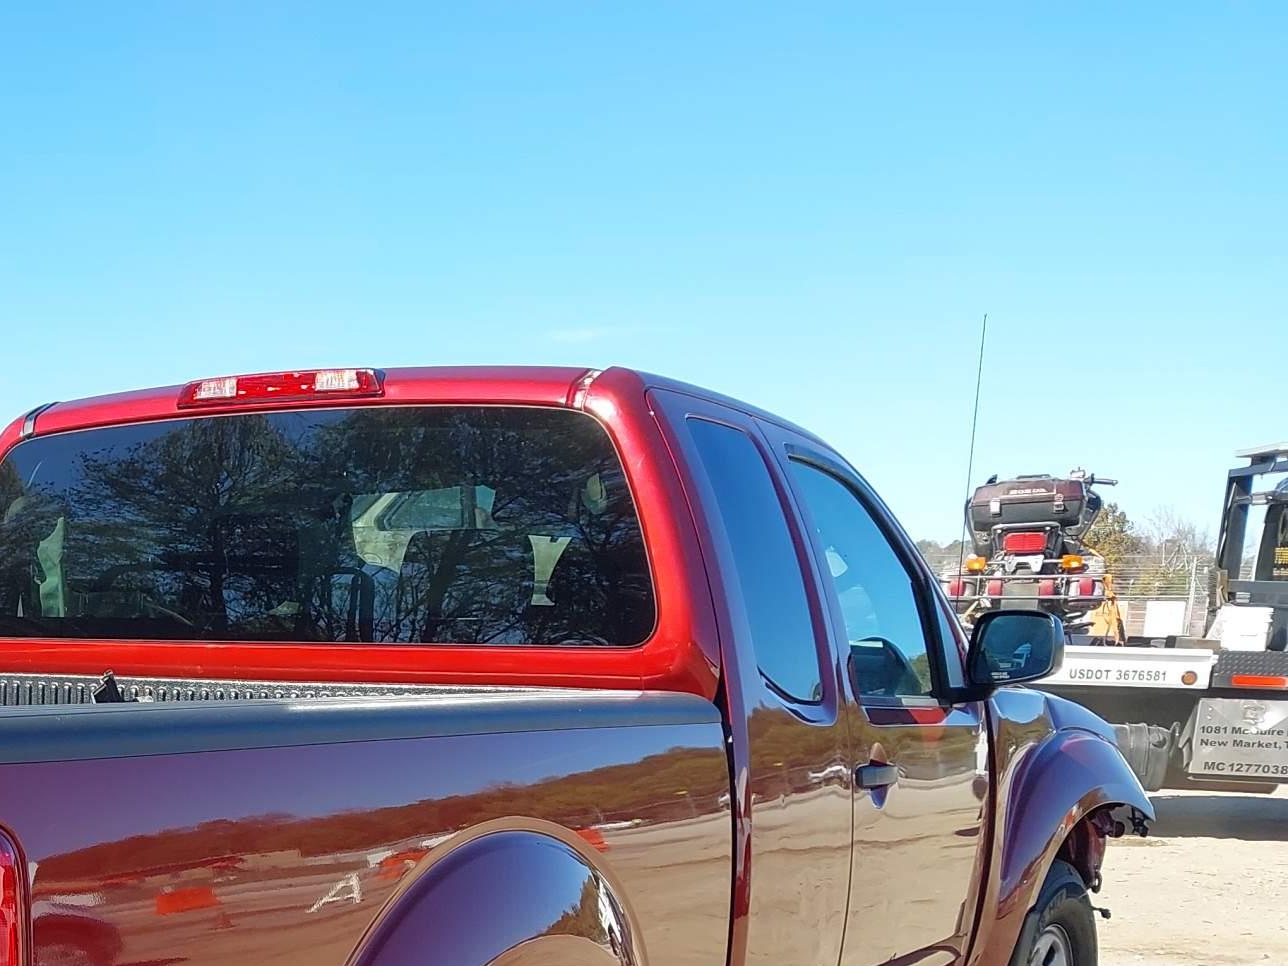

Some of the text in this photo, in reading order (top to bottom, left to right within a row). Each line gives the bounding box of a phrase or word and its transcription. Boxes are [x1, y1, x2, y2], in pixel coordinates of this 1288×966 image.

[1068, 668, 1168, 682] USDOT 3676581
[1200, 726, 1228, 735] 1081
[1200, 739, 1228, 747] New
[1232, 740, 1282, 750] Market,
